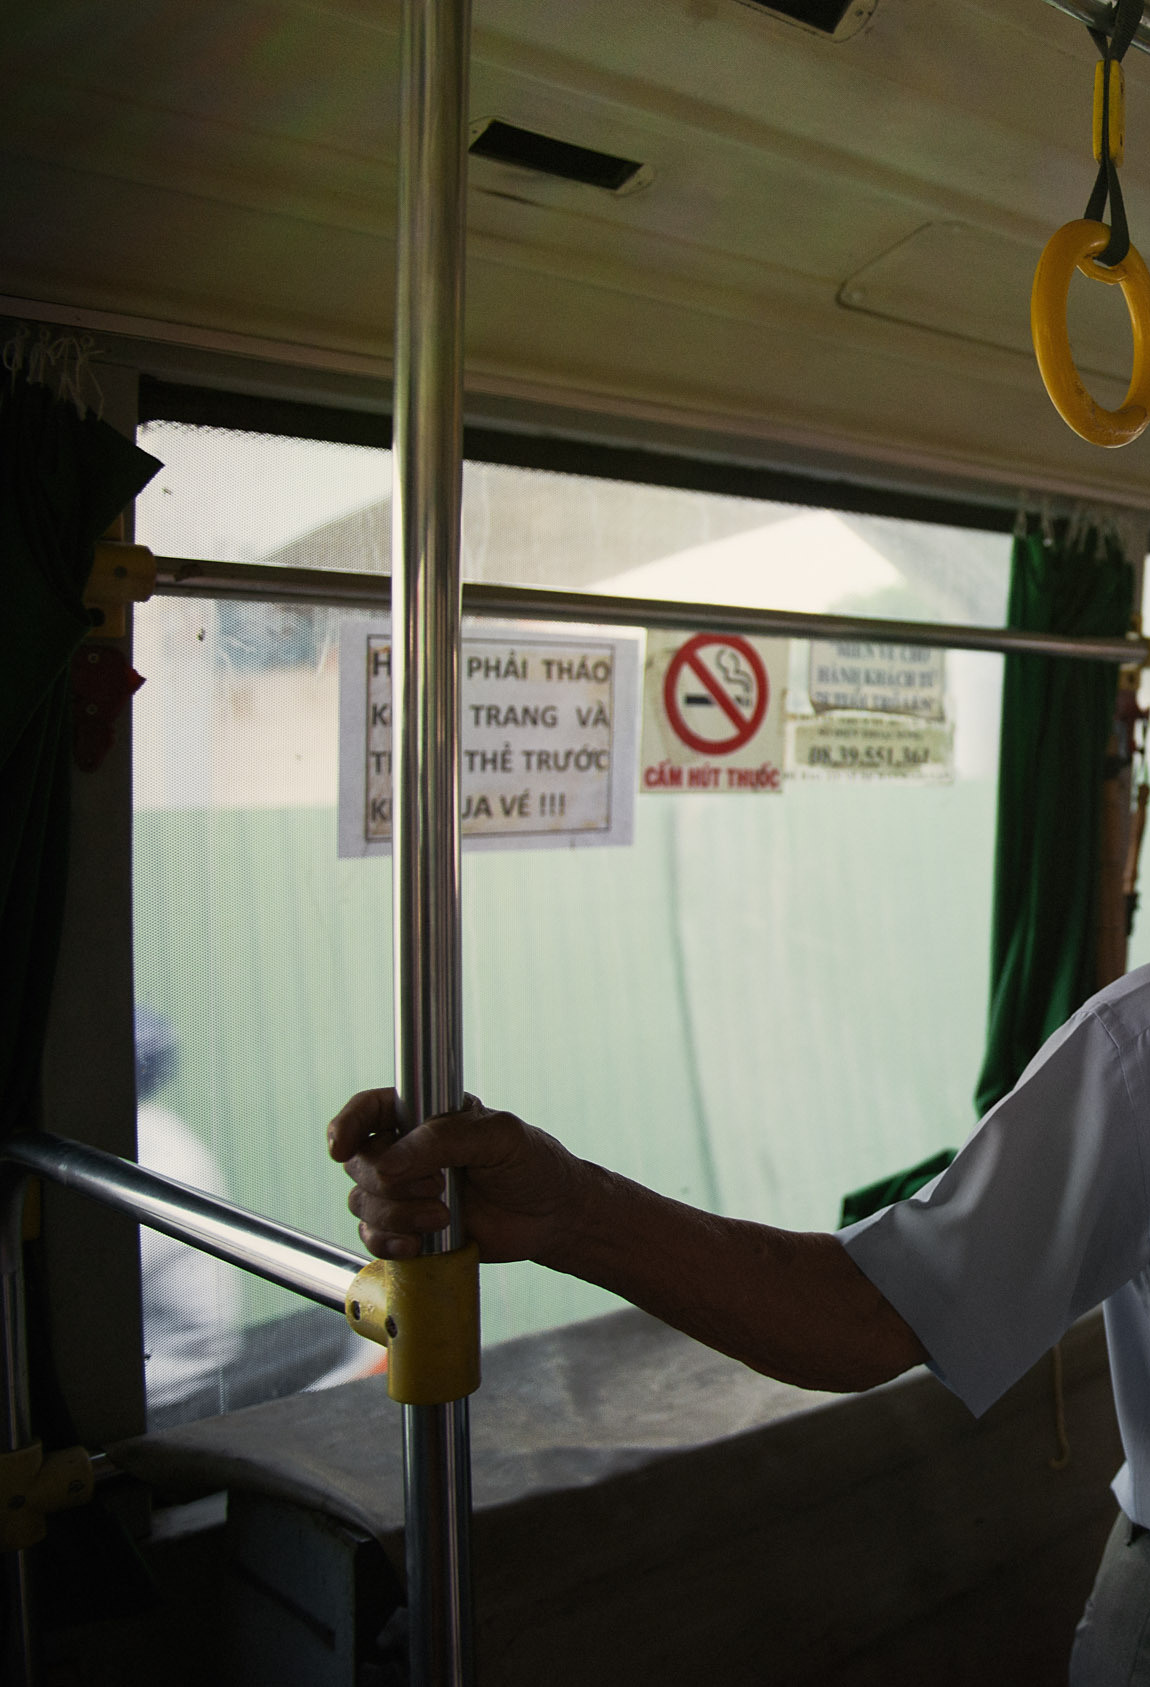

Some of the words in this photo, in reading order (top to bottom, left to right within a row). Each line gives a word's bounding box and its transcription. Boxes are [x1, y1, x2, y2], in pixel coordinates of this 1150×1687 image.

[466, 649, 528, 680] PHẢI
[469, 704, 558, 728] TRANG
[575, 699, 611, 728] VÀ
[464, 741, 513, 773] THẺ
[520, 746, 611, 772] TRƯỚC
[643, 758, 683, 788] CẤM
[687, 761, 721, 788] HÚT
[726, 761, 781, 789] THUỐC
[499, 788, 531, 817] VÉ
[538, 792, 567, 817] !!!
